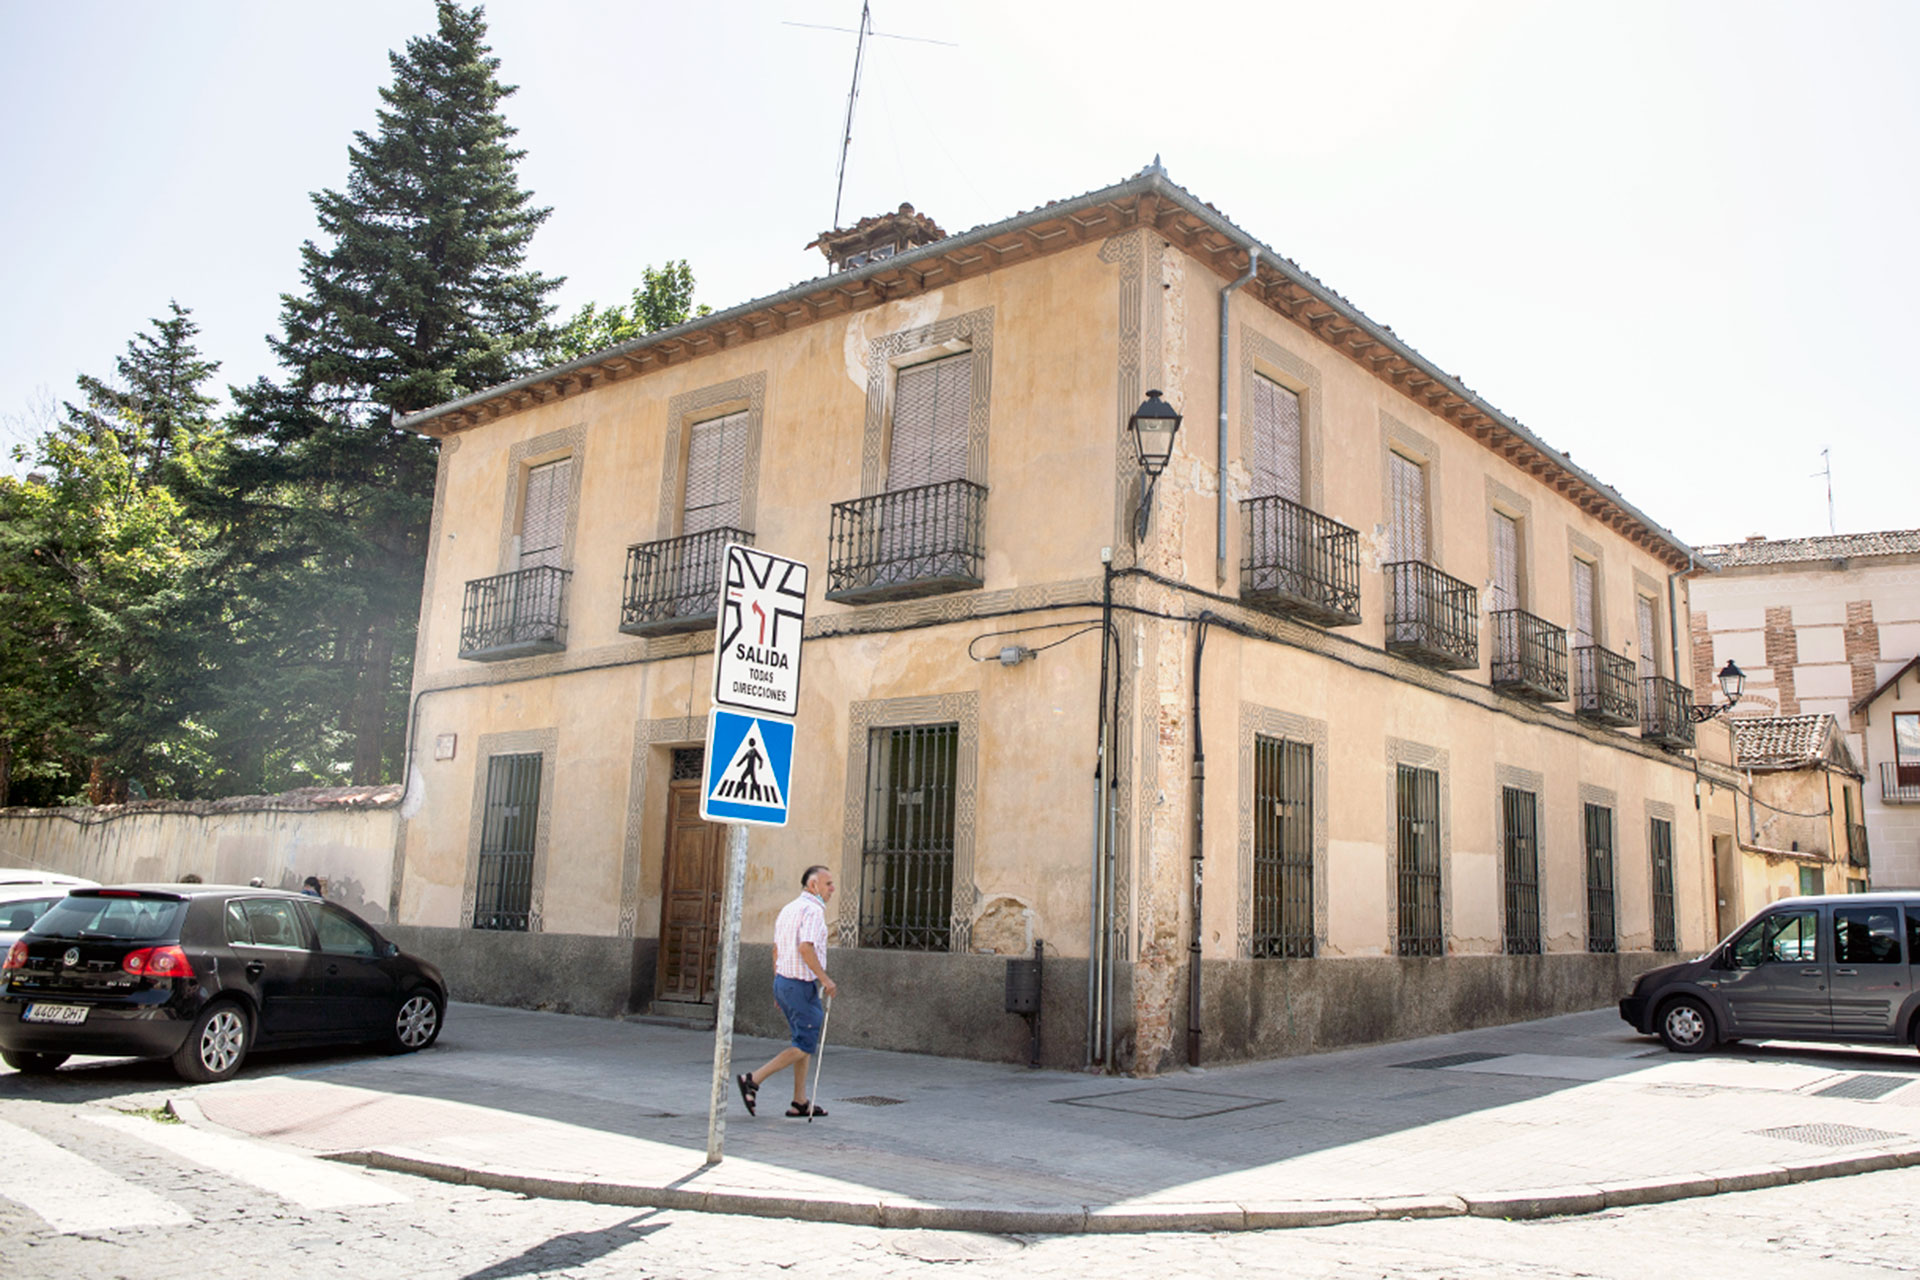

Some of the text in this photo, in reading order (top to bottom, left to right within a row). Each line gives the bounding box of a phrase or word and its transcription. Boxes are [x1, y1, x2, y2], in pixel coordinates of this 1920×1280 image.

[736, 643, 788, 669] SALIDA
[749, 668, 773, 683] TODAS
[733, 681, 786, 702] DIRECCIONES
[34, 1005, 62, 1018] 4407
